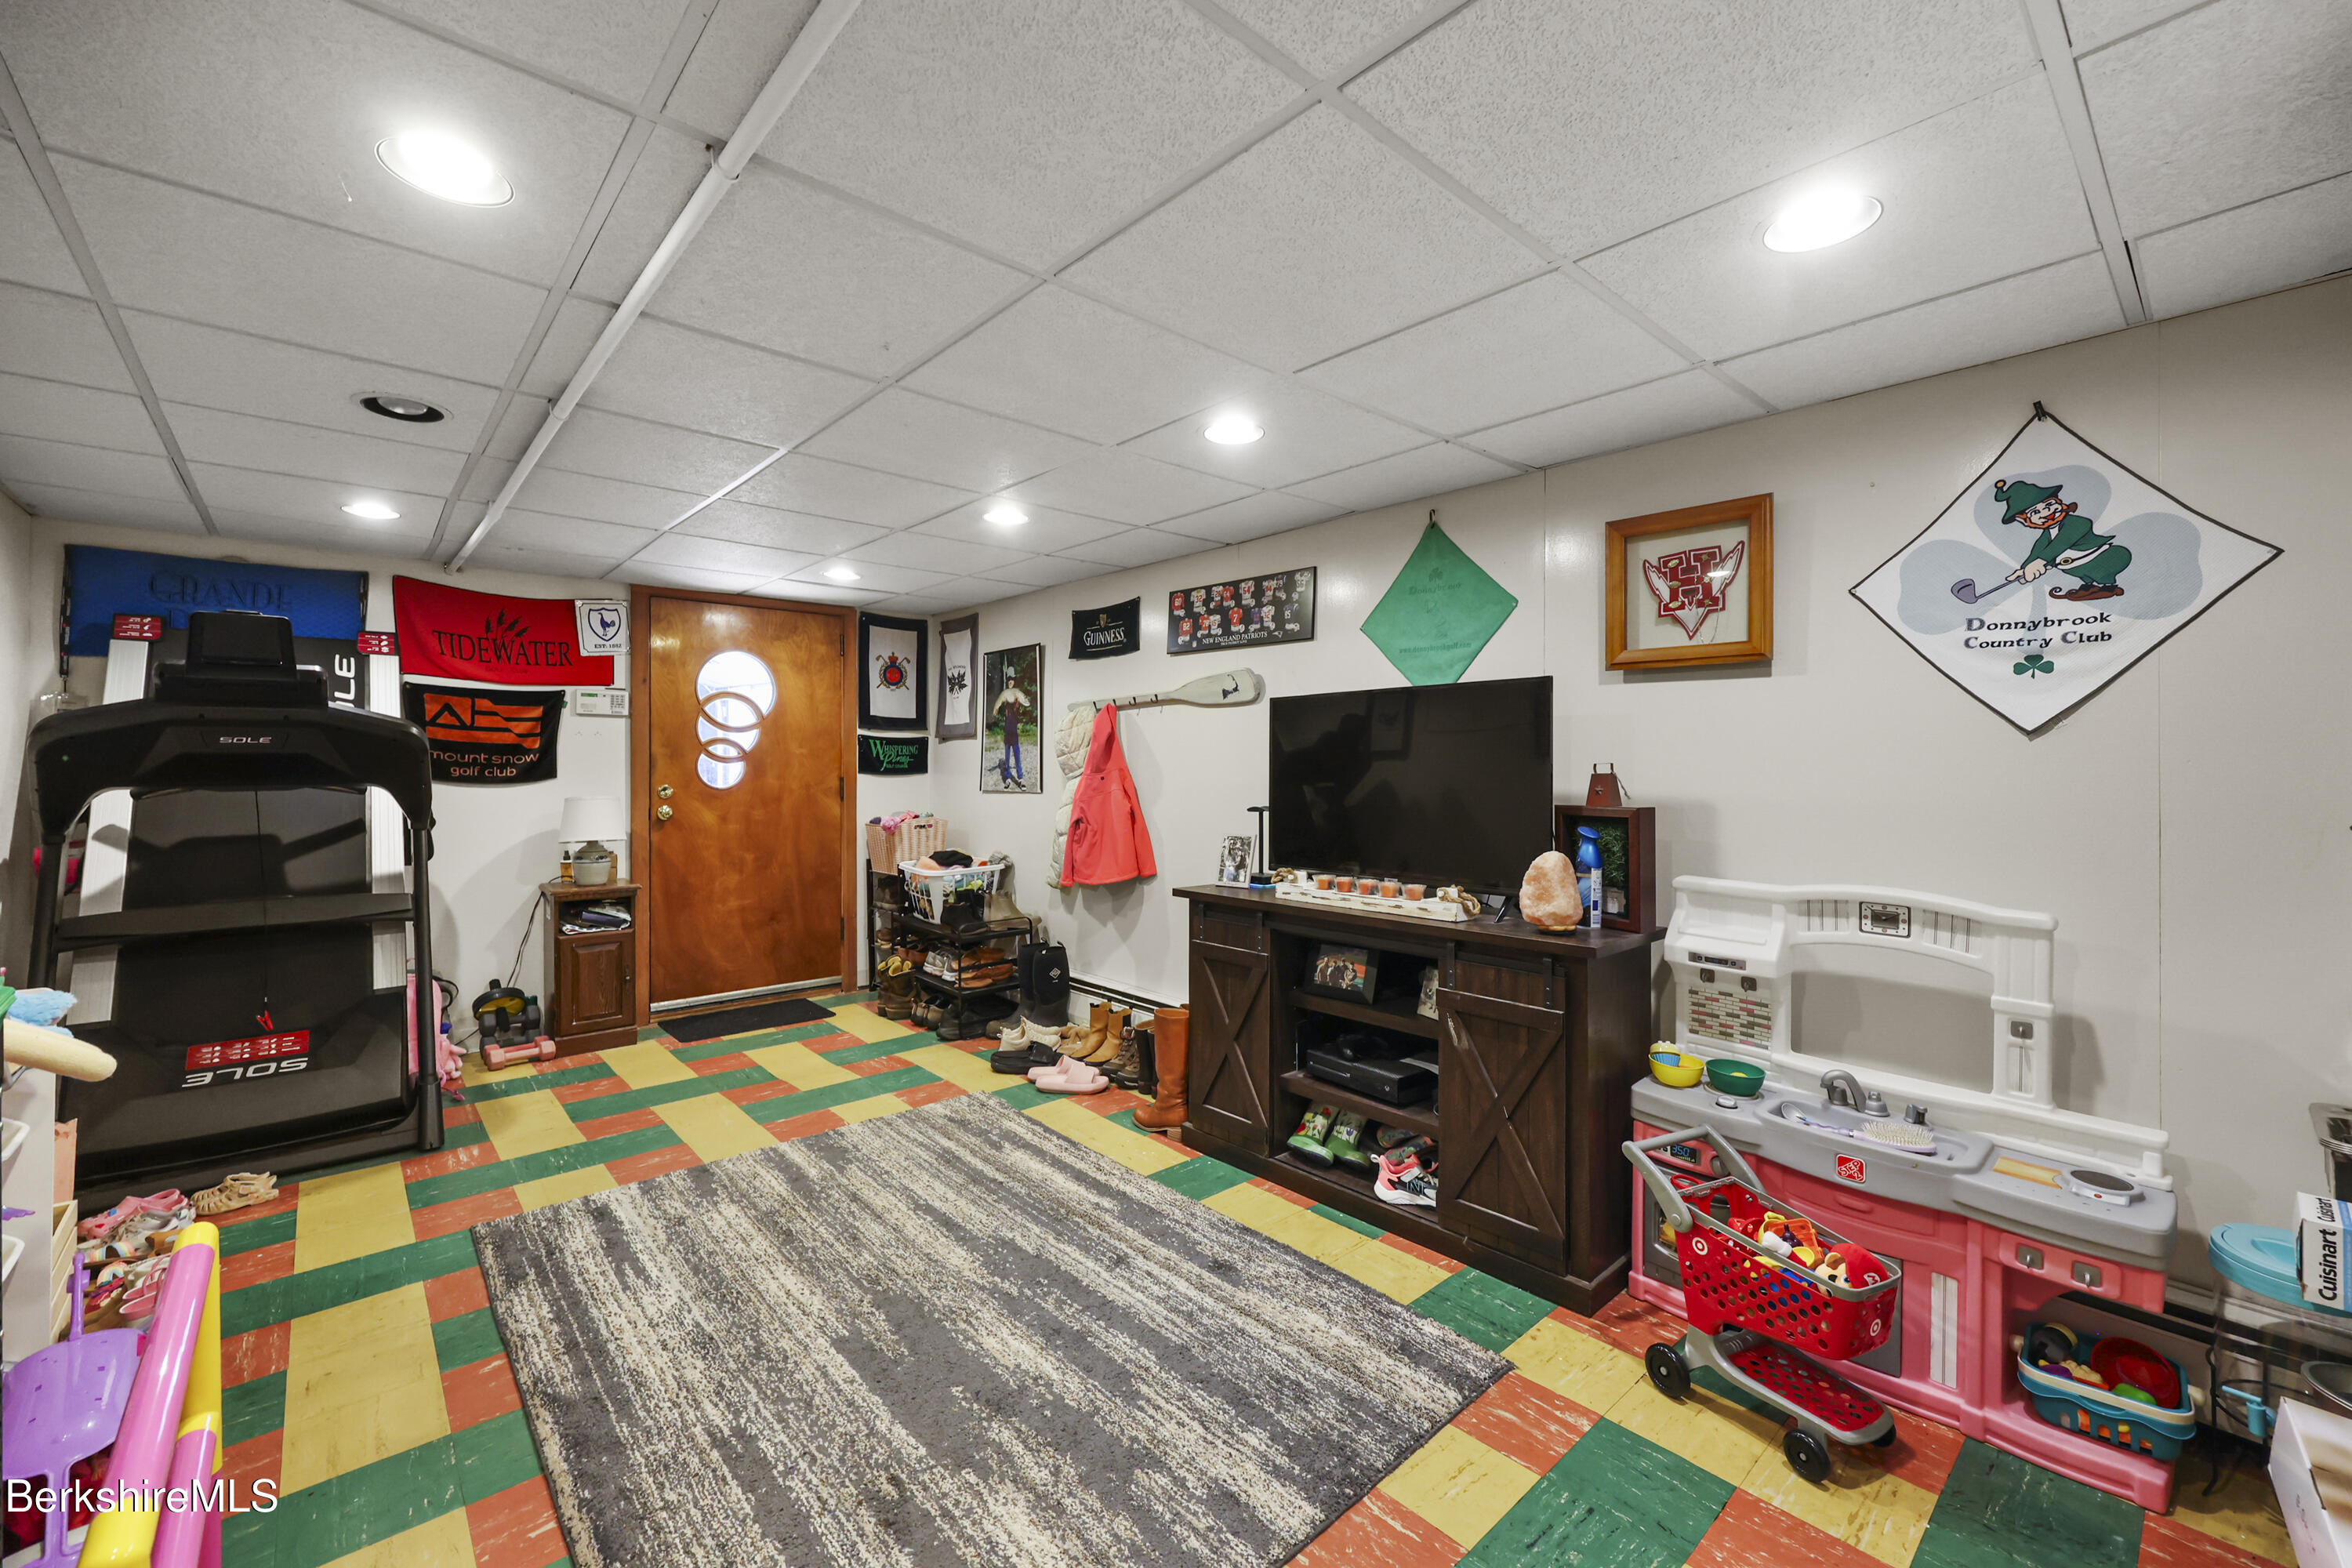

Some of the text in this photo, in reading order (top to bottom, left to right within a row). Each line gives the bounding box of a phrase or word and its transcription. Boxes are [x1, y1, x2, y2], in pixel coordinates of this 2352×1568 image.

[1232, 614, 1238, 622] 7
[1965, 612, 2113, 632] Donnybrook
[1083, 627, 1124, 646] GUINNESS
[1214, 634, 1241, 643] ENGLAND
[1241, 631, 1268, 640] PATRIOTS
[1963, 630, 2113, 649] Country Club
[432, 630, 574, 666] TIDEWATER
[430, 750, 539, 764] mount snow
[868, 739, 919, 760] WHISPERING
[450, 766, 517, 777] golf club
[181, 1057, 309, 1088] SOLE
[1671, 1145, 1690, 1157] 350
[1838, 1160, 1861, 1176] STEP
[1852, 1171, 1864, 1181] 2
[2314, 1197, 2336, 1222] Cuisinart
[2318, 1229, 2337, 1301] Cuisinart
